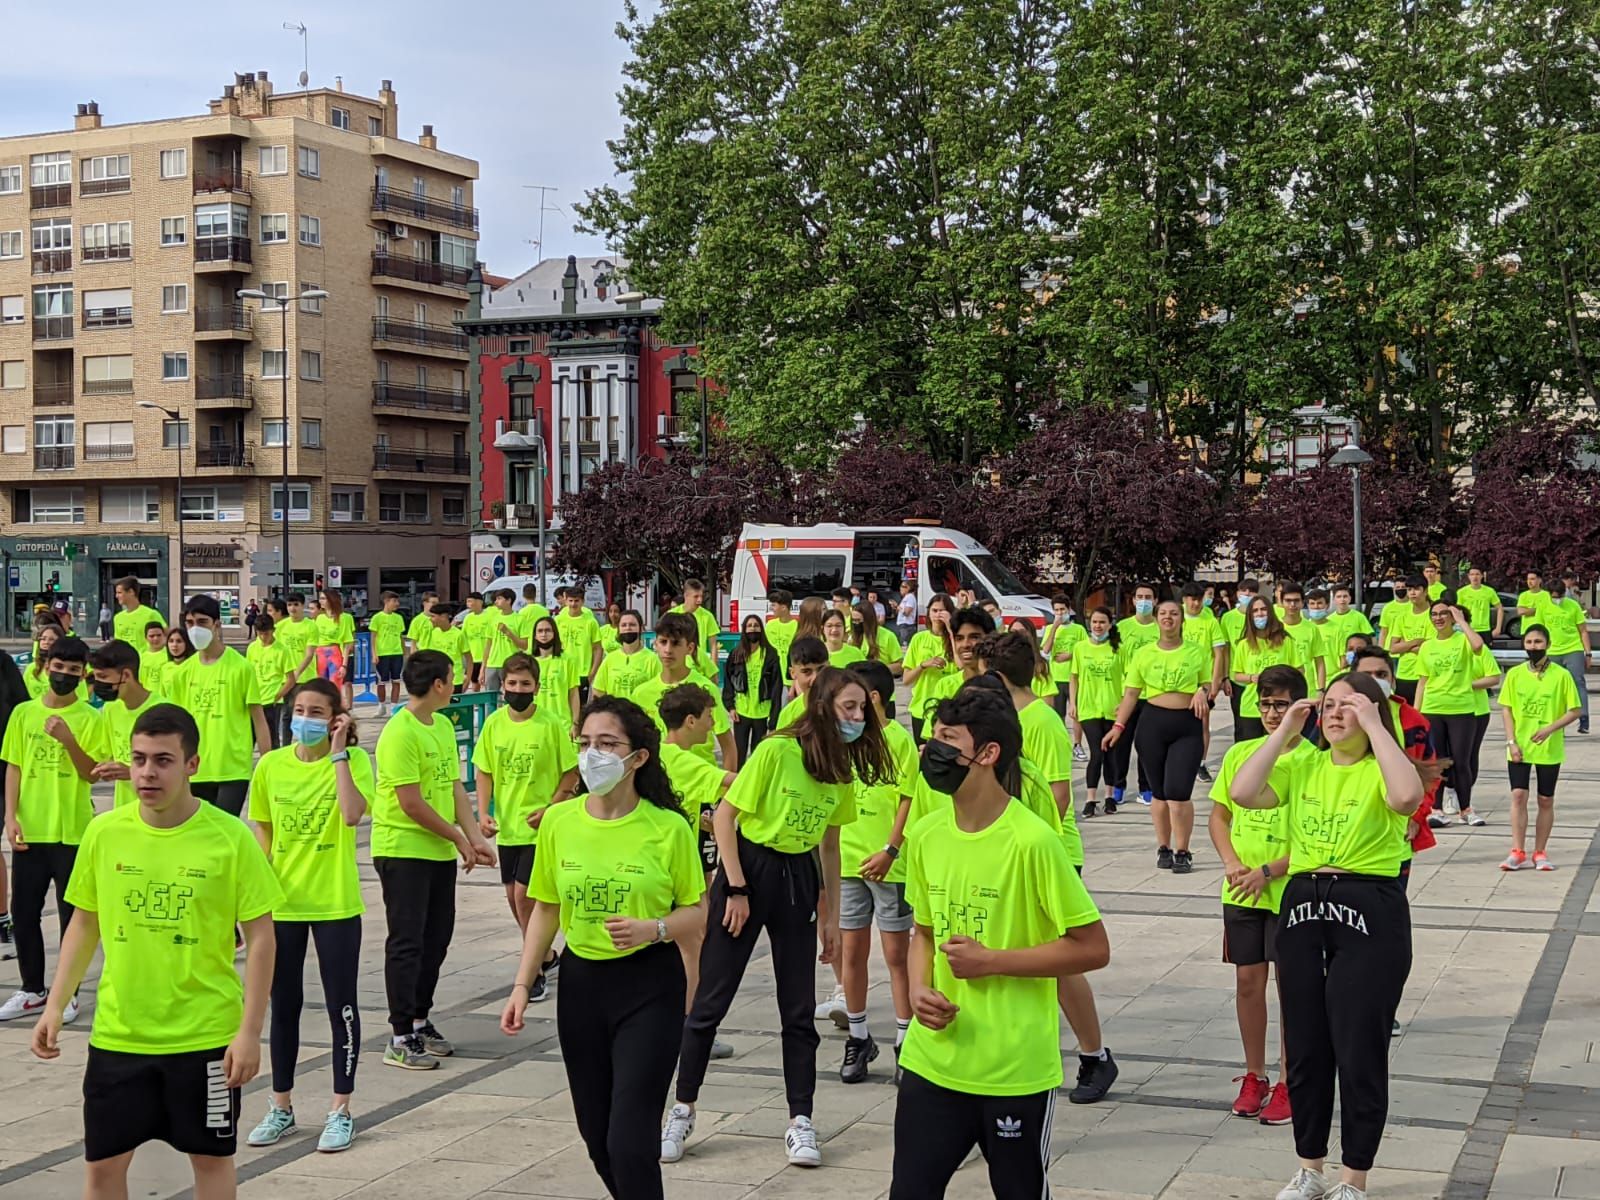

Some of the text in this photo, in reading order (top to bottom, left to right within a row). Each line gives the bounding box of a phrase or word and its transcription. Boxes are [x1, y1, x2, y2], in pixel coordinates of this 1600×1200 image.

[16, 543, 59, 552] ORTOPEDIA
[106, 543, 146, 551] FARMACIA
[1286, 901, 1370, 936] ATLANTA
[206, 1060, 230, 1128] PUMA
